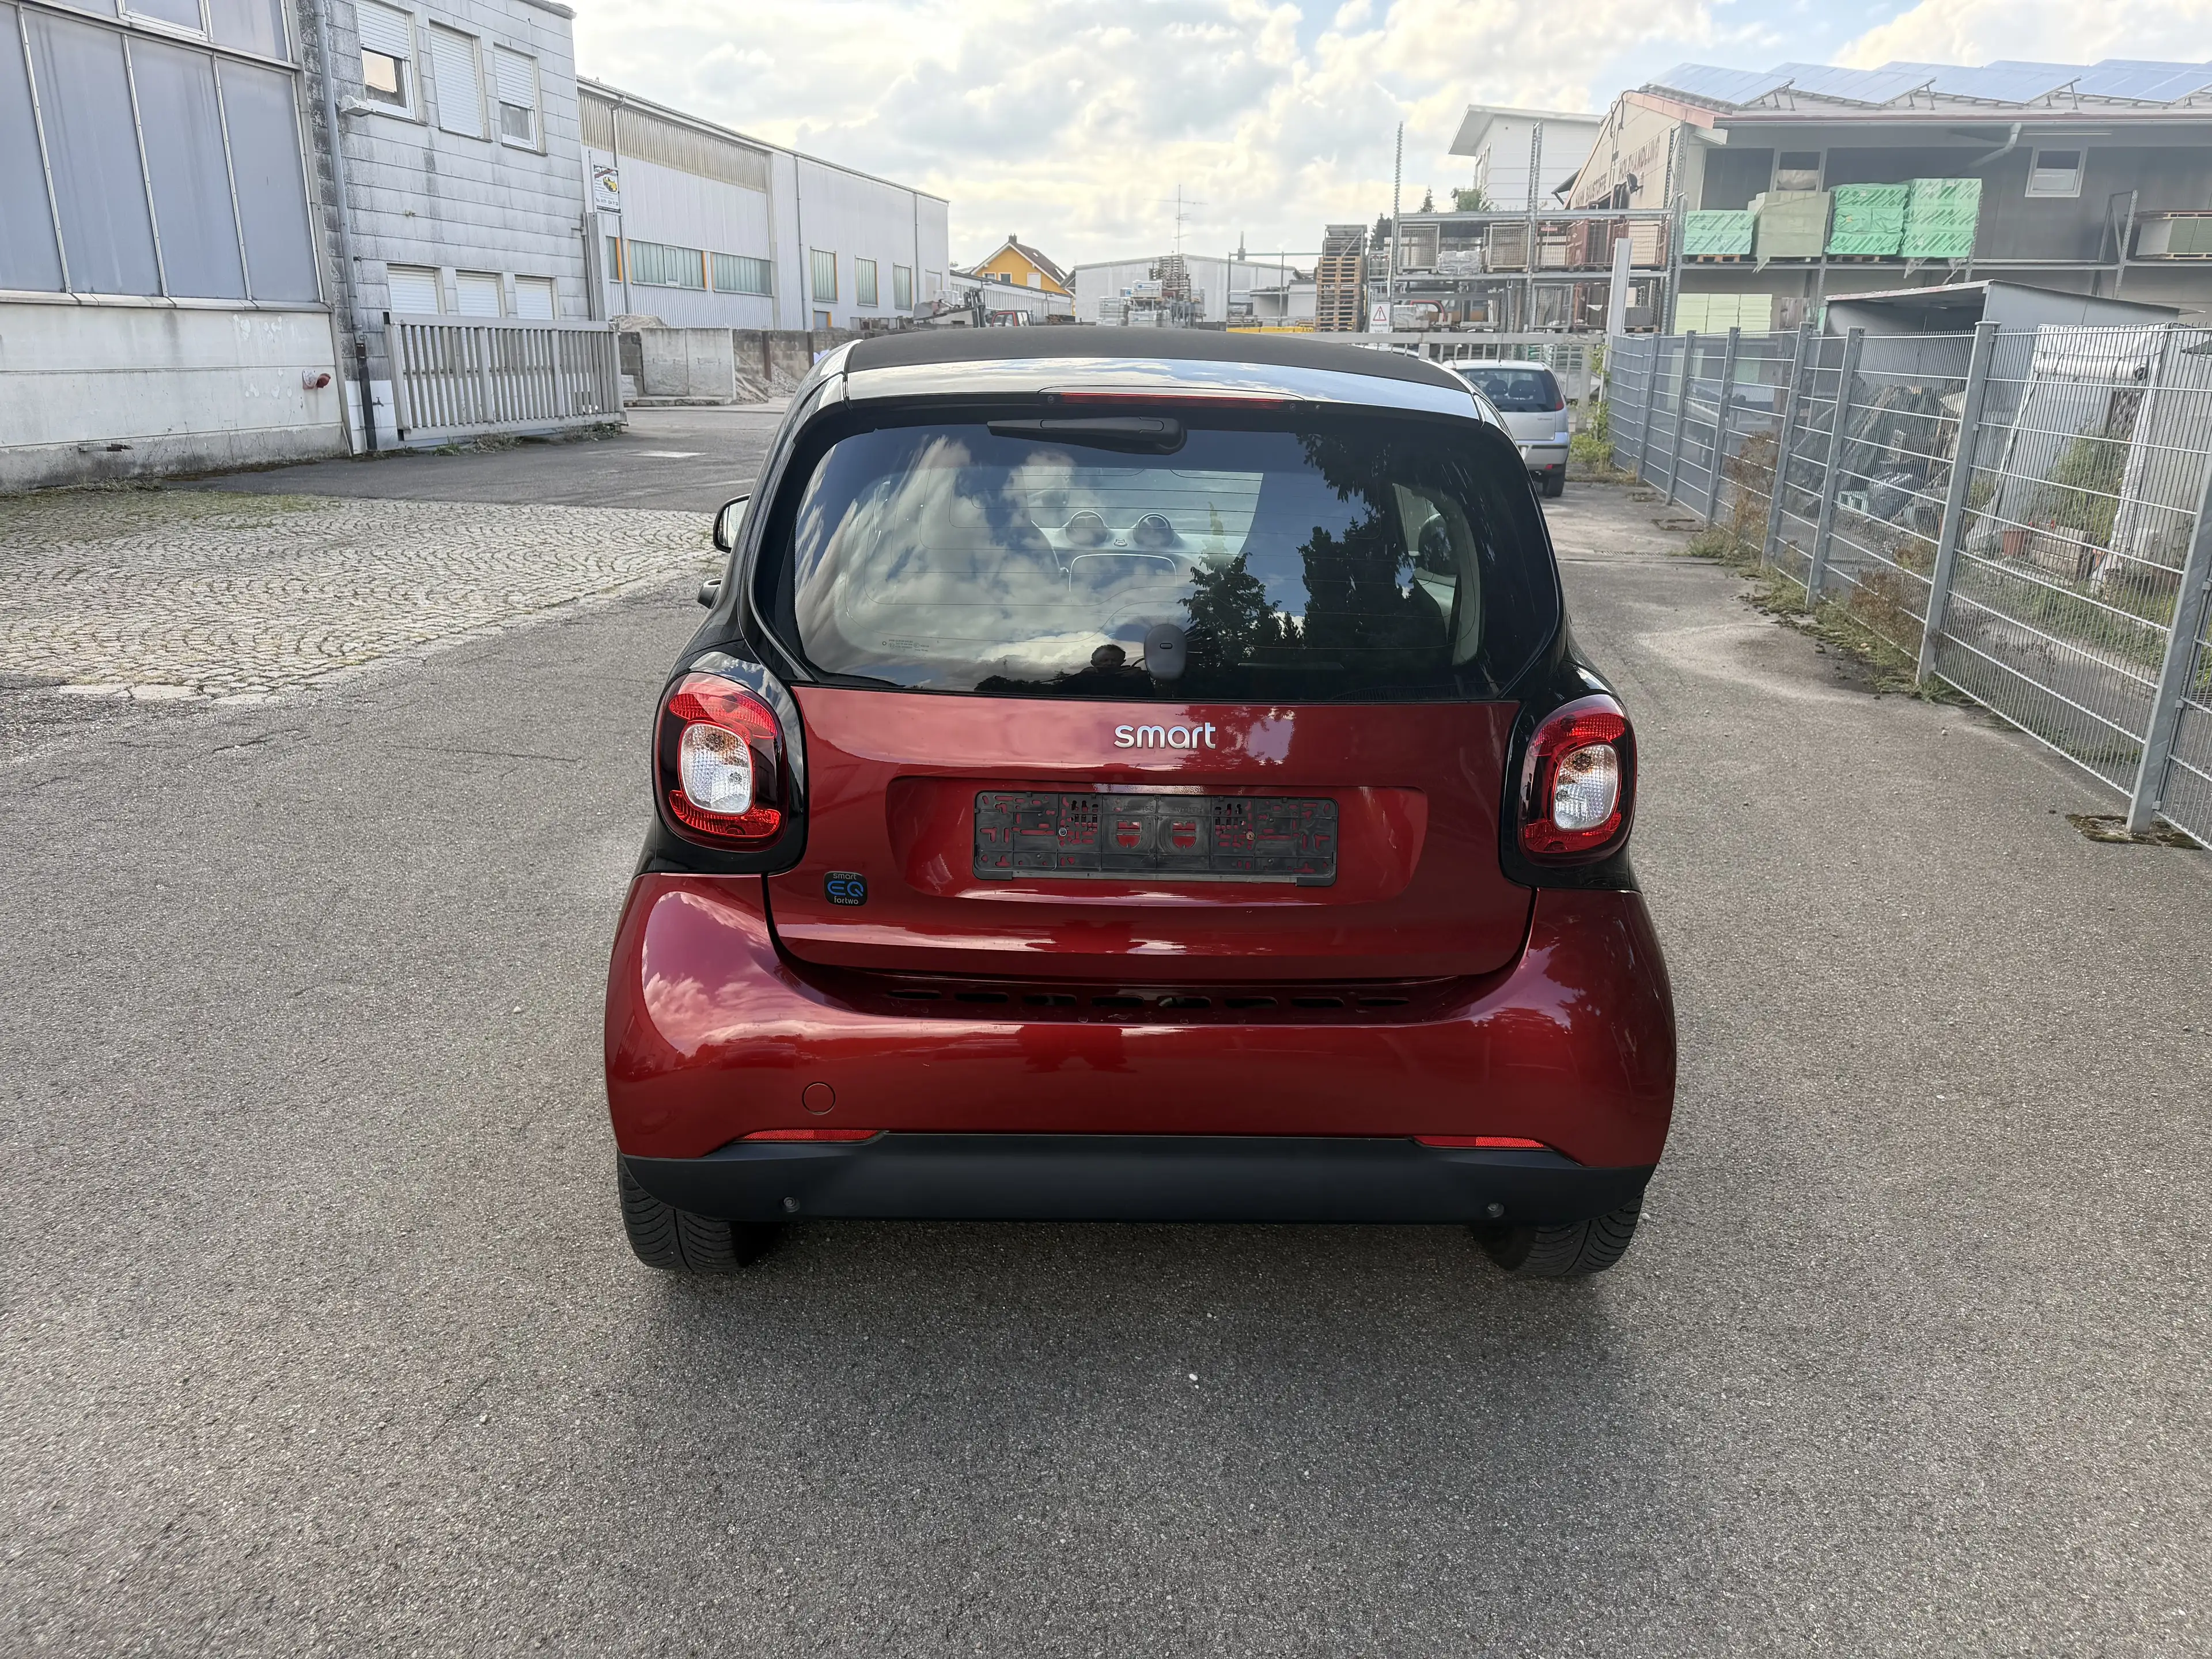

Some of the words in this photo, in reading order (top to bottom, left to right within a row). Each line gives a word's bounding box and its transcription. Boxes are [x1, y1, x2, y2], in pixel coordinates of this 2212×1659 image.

[1113, 722, 1216, 749] smart
[827, 880, 864, 897] EQ
[834, 896, 859, 904] fortwo
